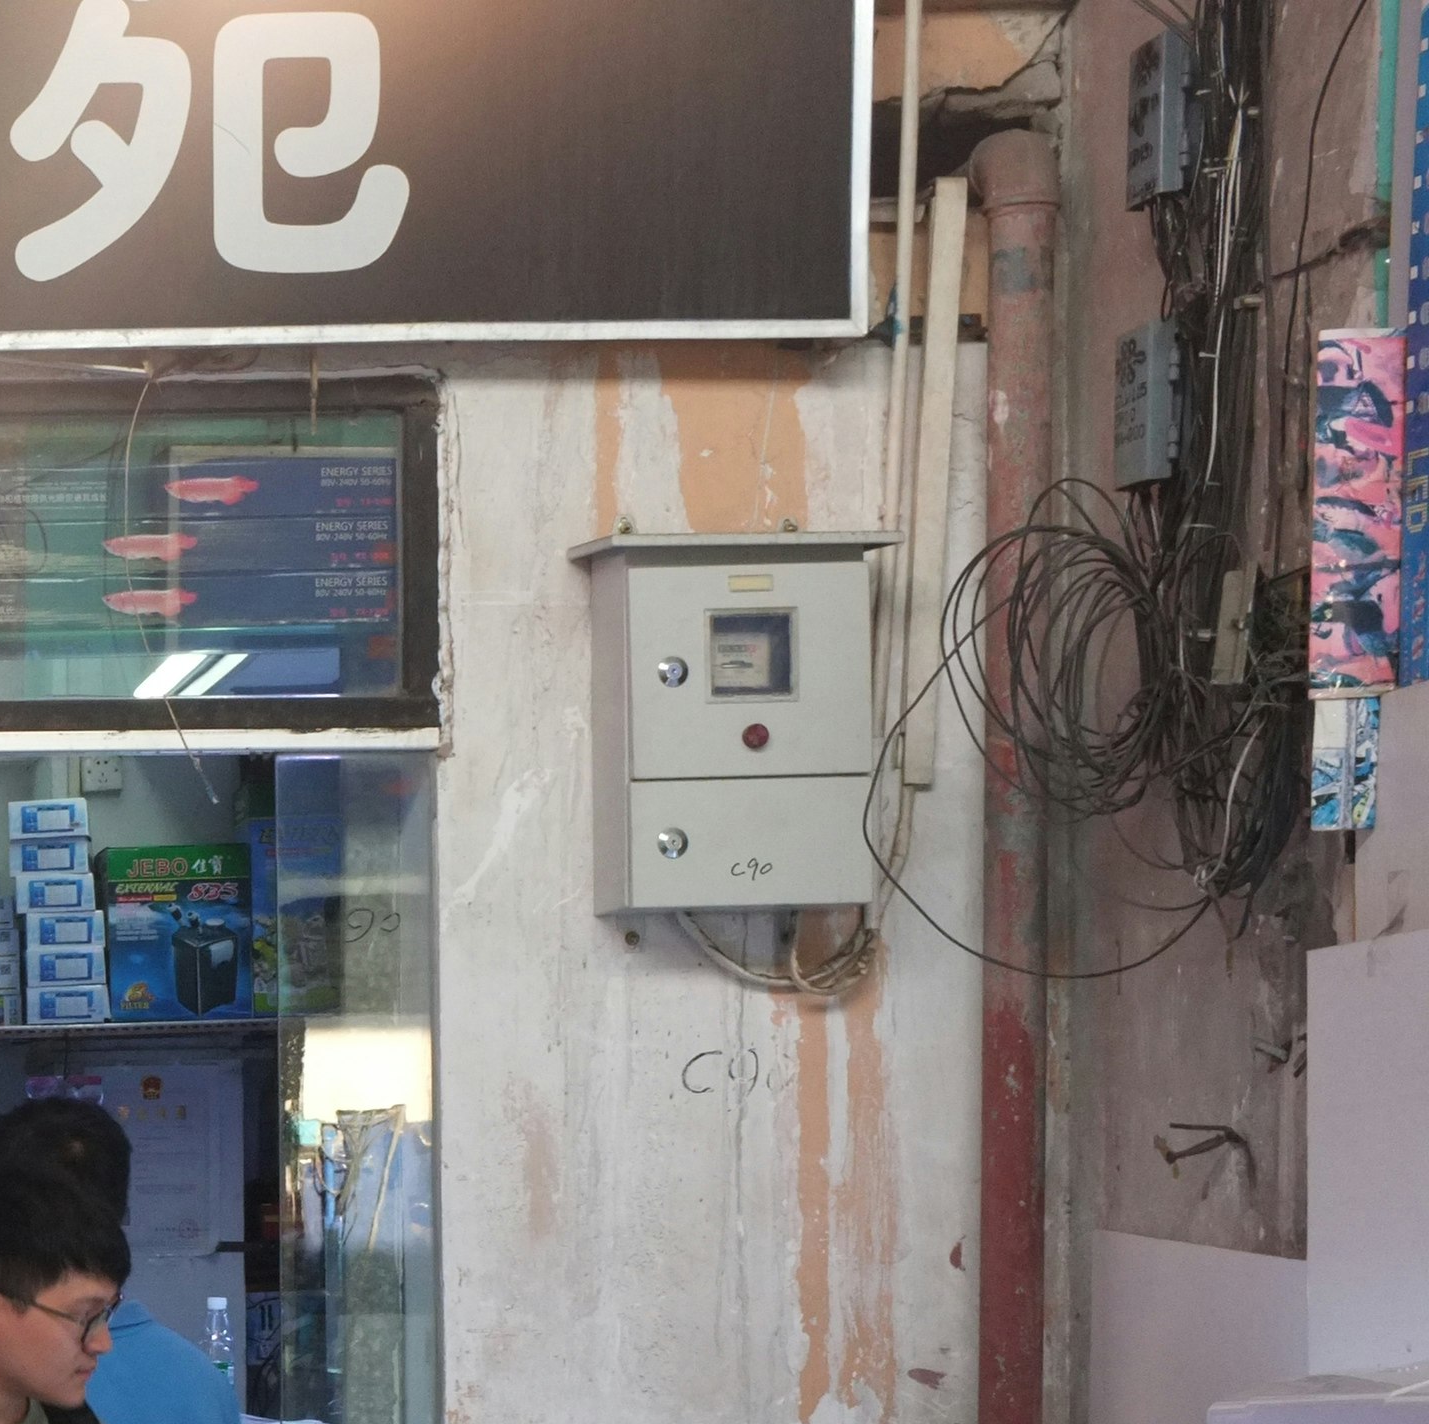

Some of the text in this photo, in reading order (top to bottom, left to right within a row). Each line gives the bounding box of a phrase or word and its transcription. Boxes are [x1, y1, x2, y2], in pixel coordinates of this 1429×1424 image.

[321, 466, 393, 477] ENERGY SERIES
[315, 521, 388, 532] ENERGY SERIES
[315, 576, 388, 587] ENERGY SERIES
[126, 858, 189, 877] JEBO
[730, 857, 773, 881] C90
